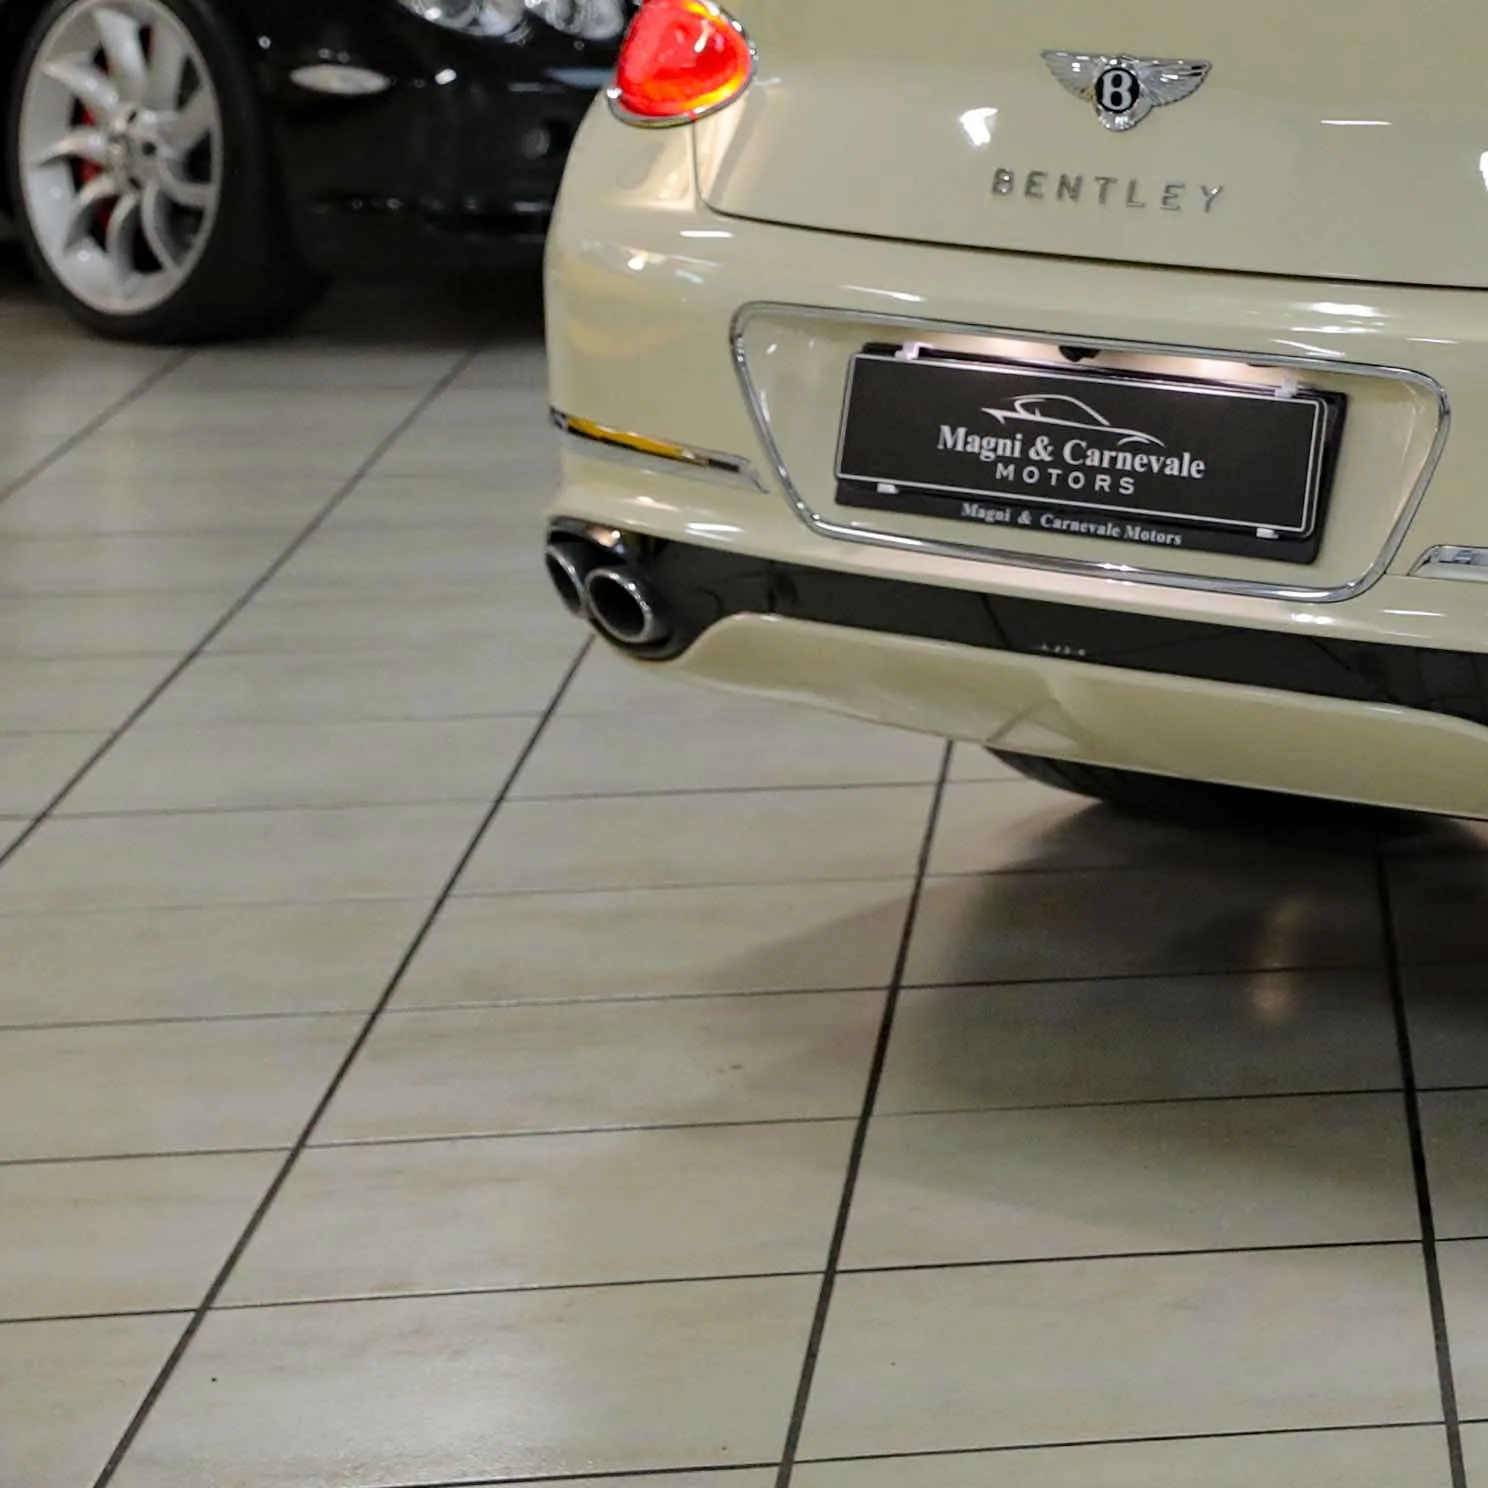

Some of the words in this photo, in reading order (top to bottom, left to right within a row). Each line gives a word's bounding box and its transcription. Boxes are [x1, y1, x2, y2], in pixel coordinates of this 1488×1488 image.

[991, 167, 1223, 213] BENTLEY
[937, 424, 1023, 462] Magni
[1028, 435, 1054, 461] &
[1062, 439, 1206, 479] Carnevale
[995, 462, 1135, 495] MOTORS
[961, 502, 1011, 523] Magni
[1017, 510, 1032, 525] &
[1040, 513, 1121, 538] Carnevale
[1122, 524, 1183, 546] Motors
